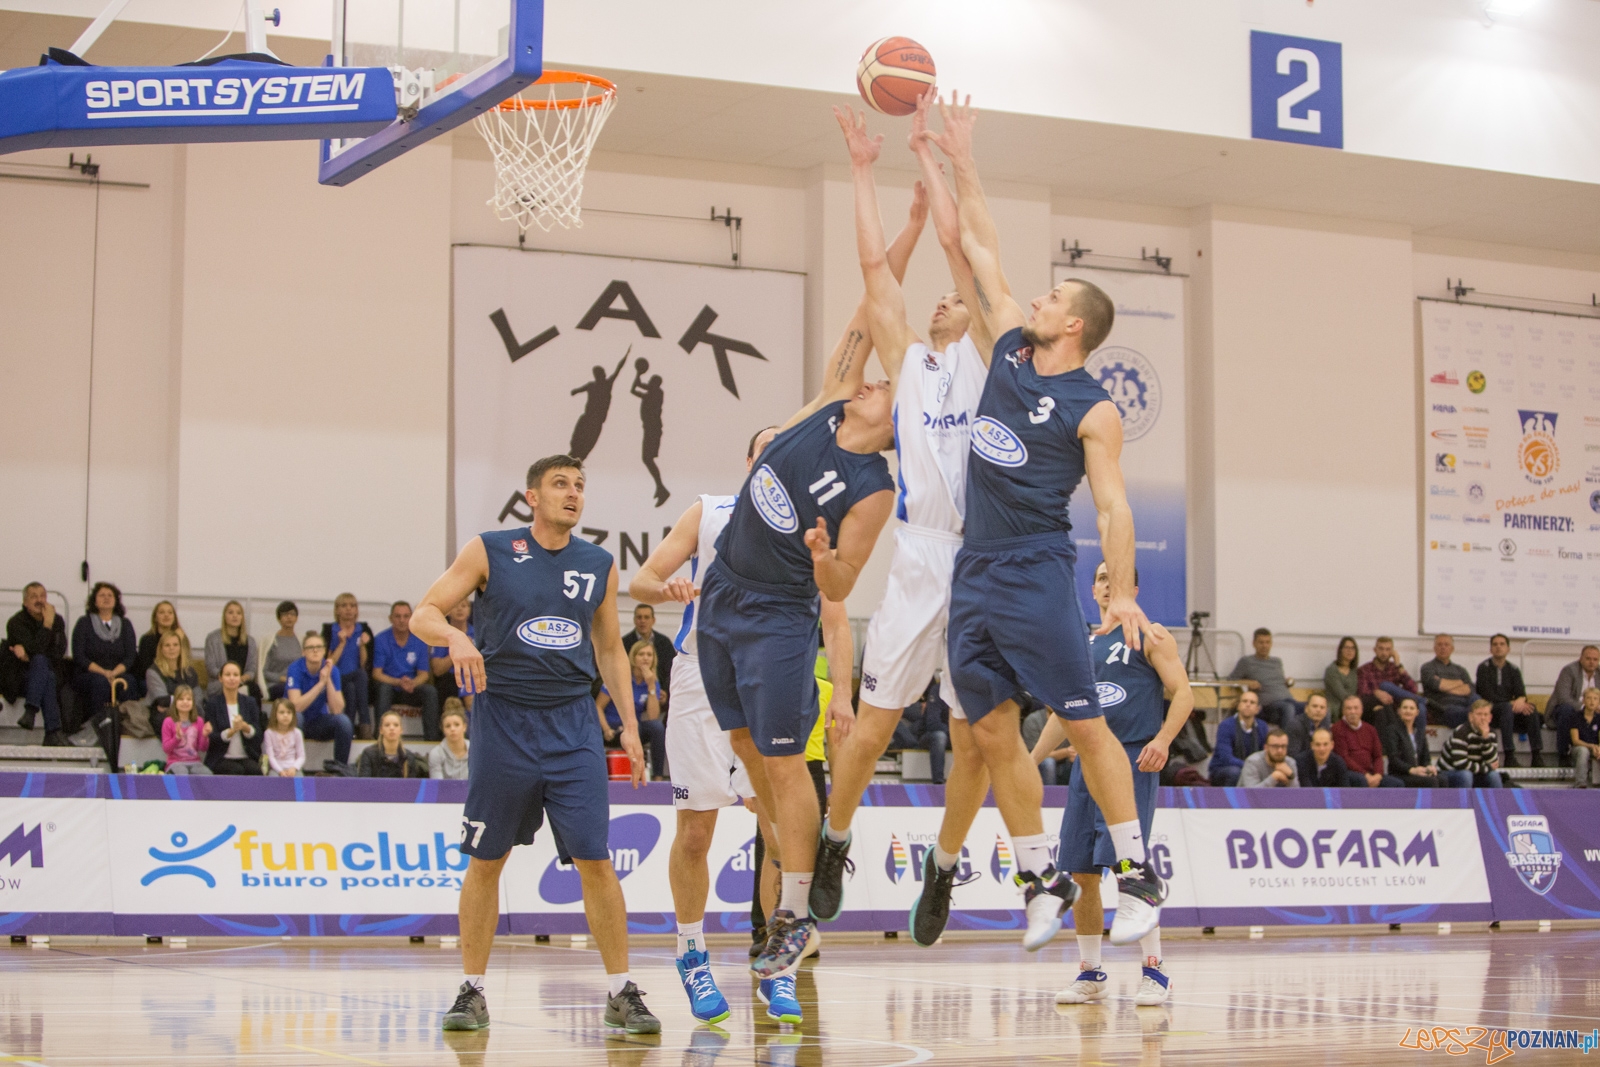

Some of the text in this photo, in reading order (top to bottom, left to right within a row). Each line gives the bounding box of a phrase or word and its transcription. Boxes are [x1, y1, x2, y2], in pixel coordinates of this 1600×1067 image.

[86, 73, 366, 115] SPORTSYSTEM
[1276, 47, 1320, 134] 2
[489, 279, 769, 401] LAK
[1029, 396, 1056, 424] 3
[809, 470, 846, 506] 11
[1504, 513, 1574, 532] PARTNERZY:
[563, 570, 596, 602] 57
[538, 622, 569, 632] MASZ
[1105, 641, 1130, 665] 21
[234, 830, 470, 871] funclub
[1226, 828, 1440, 869] BIOFARM
[1508, 853, 1561, 866] BASKET
[242, 873, 328, 887] biuro
[1250, 874, 1427, 888] POLSKI PRODUCENT LEKÓW
